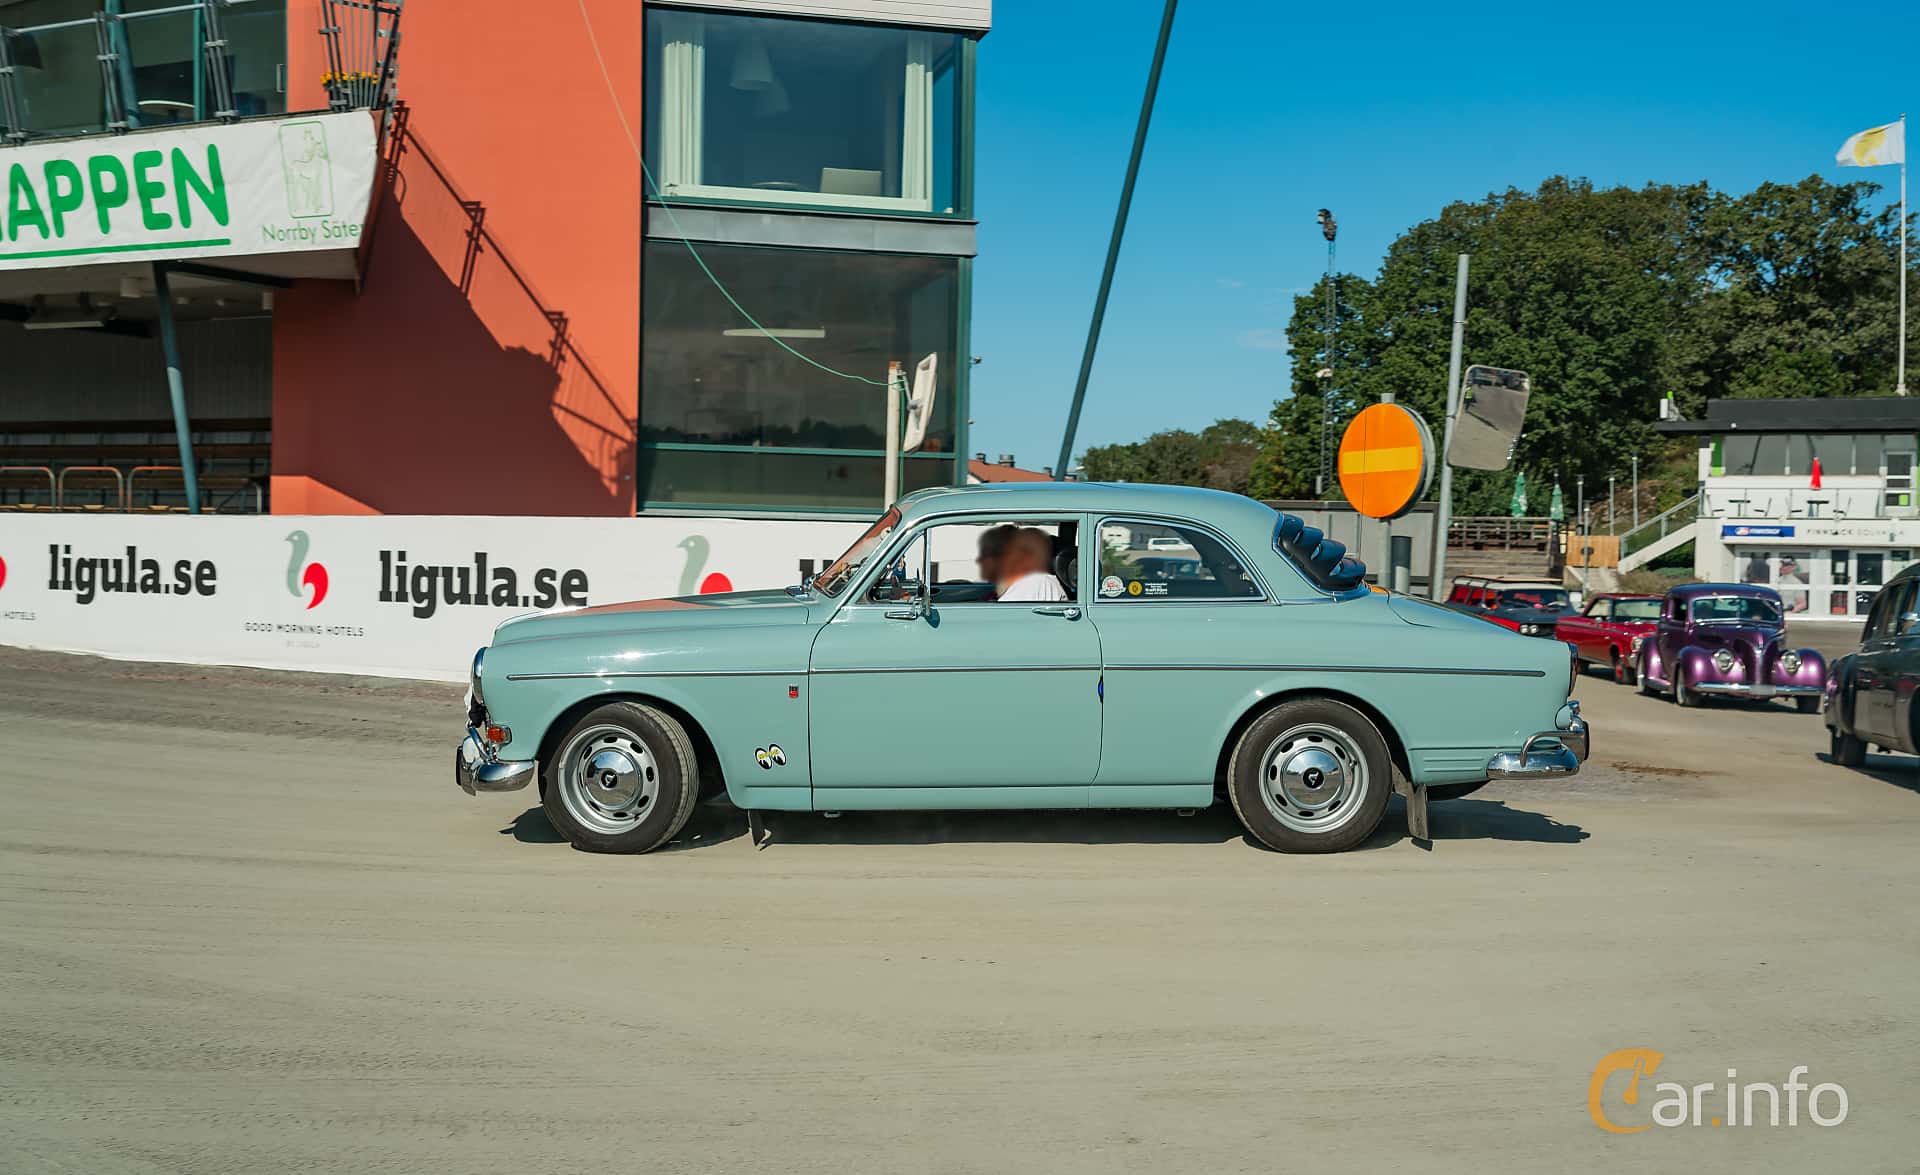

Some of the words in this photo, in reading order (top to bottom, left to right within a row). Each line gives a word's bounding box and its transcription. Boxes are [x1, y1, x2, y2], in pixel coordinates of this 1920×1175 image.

[0, 143, 229, 242] APPEN
[262, 222, 317, 244] Norrby
[48, 543, 217, 605] ligula.se
[378, 550, 589, 620] ligula.se
[244, 621, 273, 633] GOOD
[276, 623, 322, 635] MORNING
[325, 625, 365, 637] HOTELS
